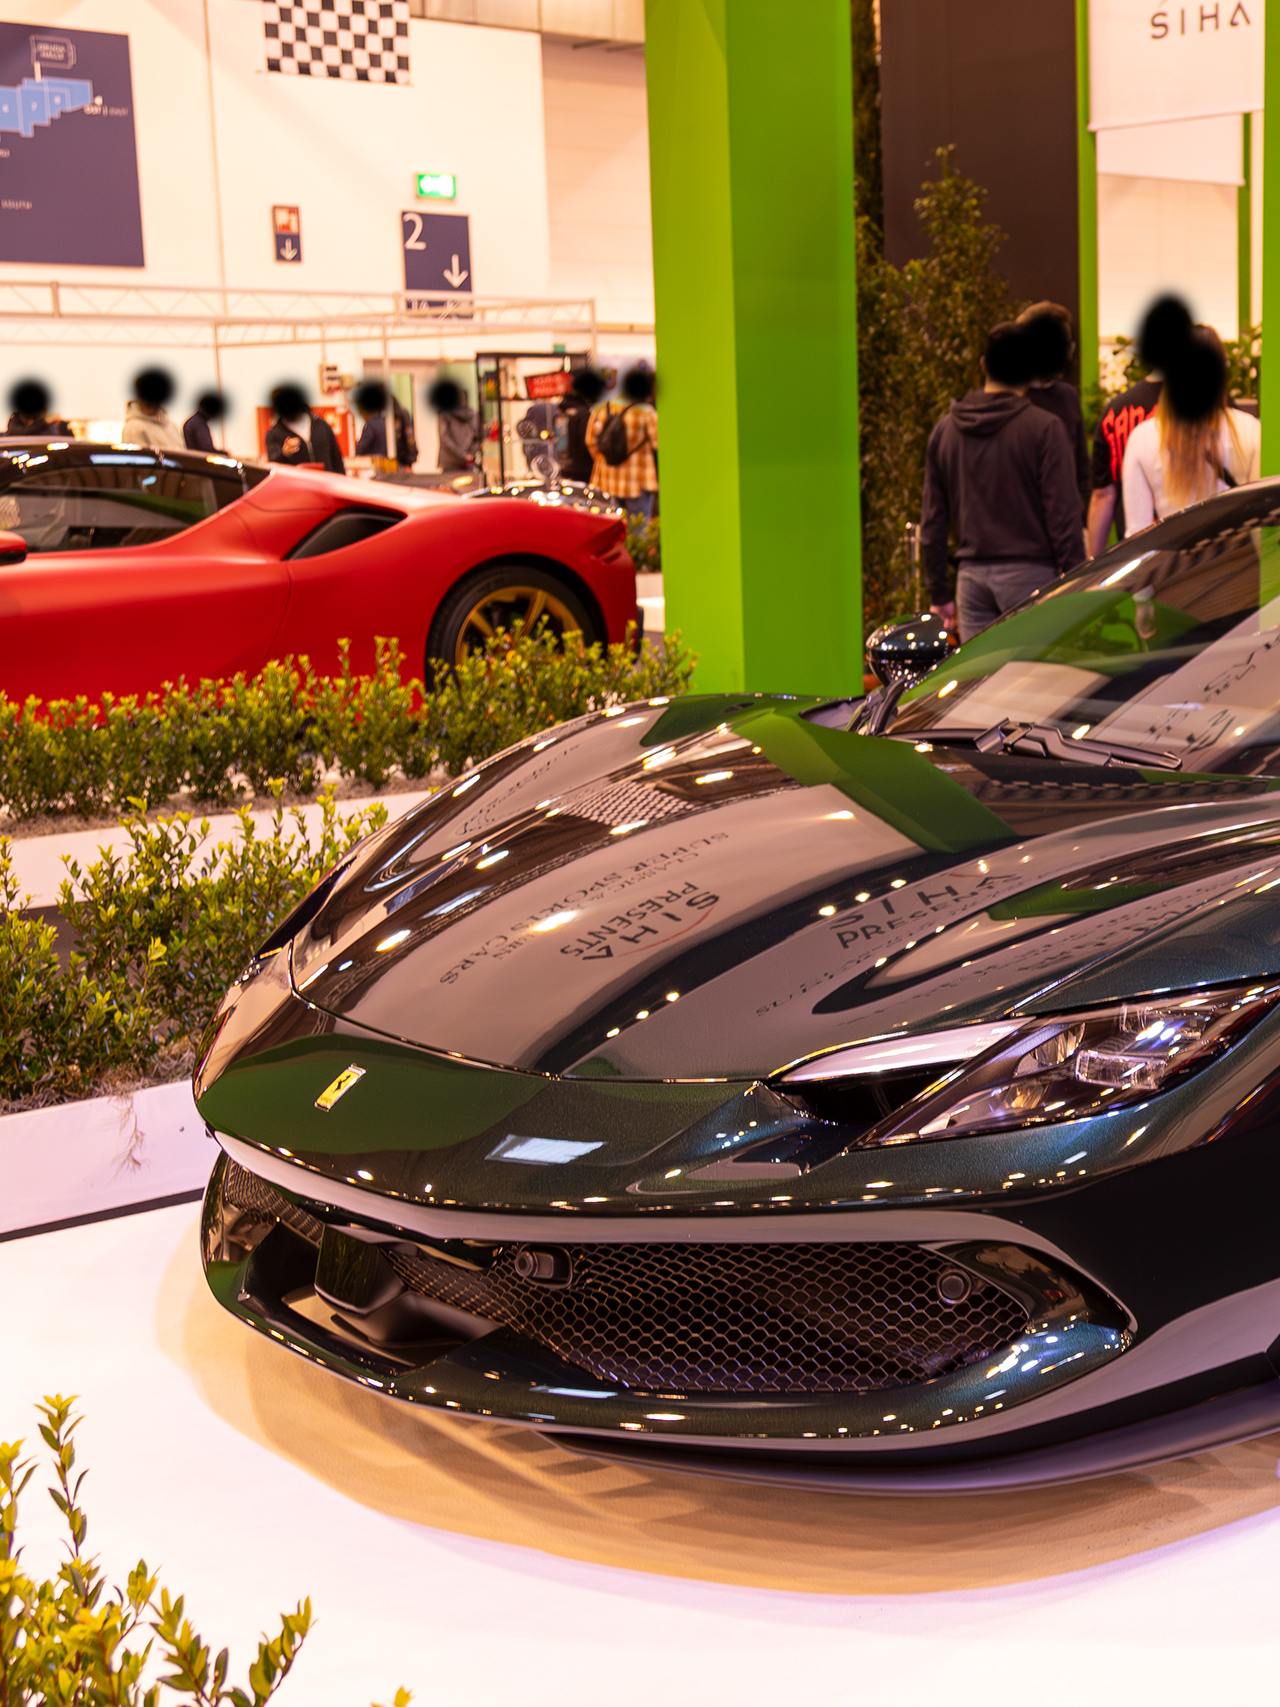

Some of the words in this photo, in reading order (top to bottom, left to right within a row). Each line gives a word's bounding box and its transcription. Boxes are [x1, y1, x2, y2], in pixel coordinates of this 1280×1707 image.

[1150, 1, 1251, 40] SIHA
[403, 212, 427, 251] 2
[560, 882, 699, 957] PRESENTS
[582, 891, 720, 960] SIHA
